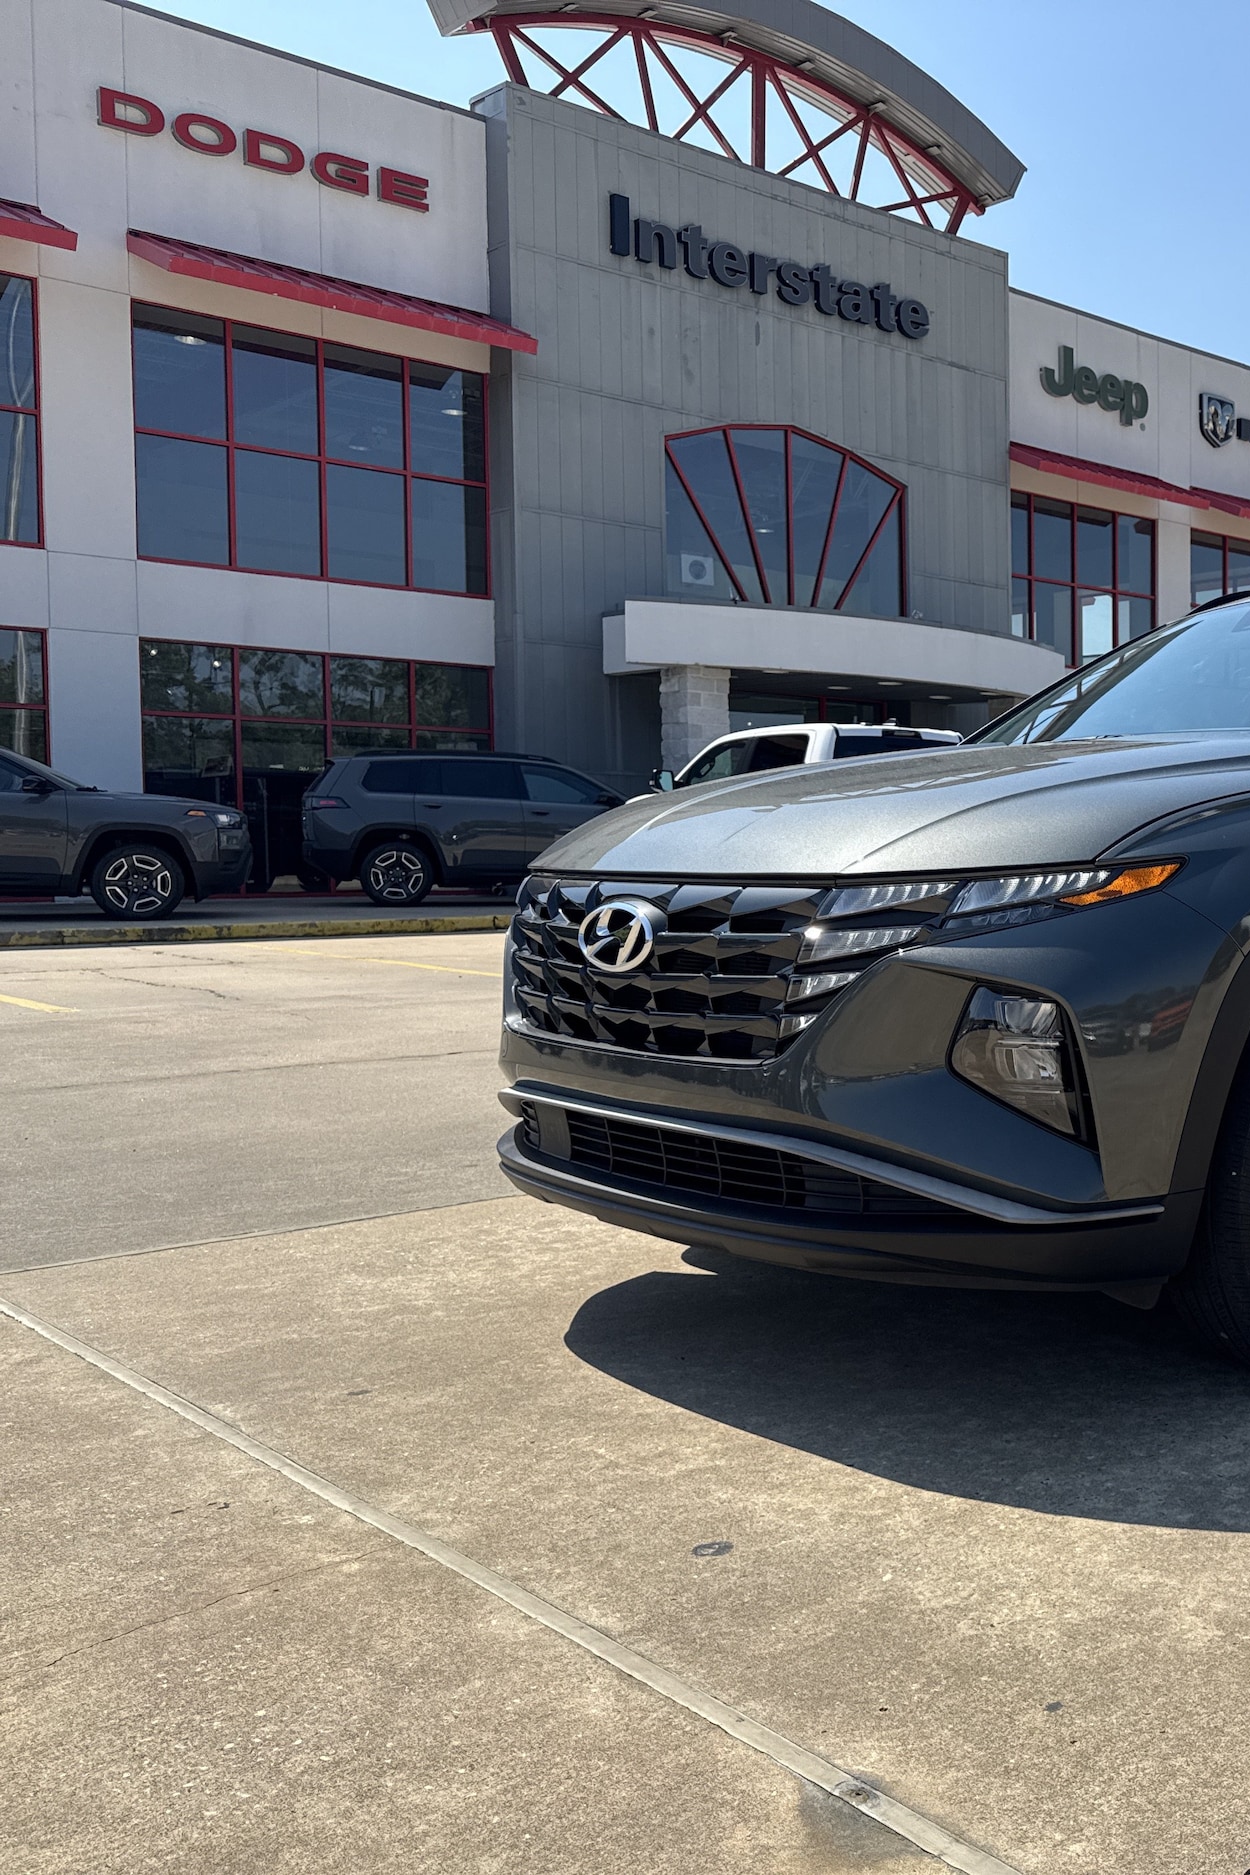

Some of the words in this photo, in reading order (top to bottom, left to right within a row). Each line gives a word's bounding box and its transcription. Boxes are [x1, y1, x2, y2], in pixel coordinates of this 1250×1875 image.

[97, 86, 429, 213] DODGE
[609, 193, 930, 339] Interstate
[1040, 345, 1148, 427] Jeep
